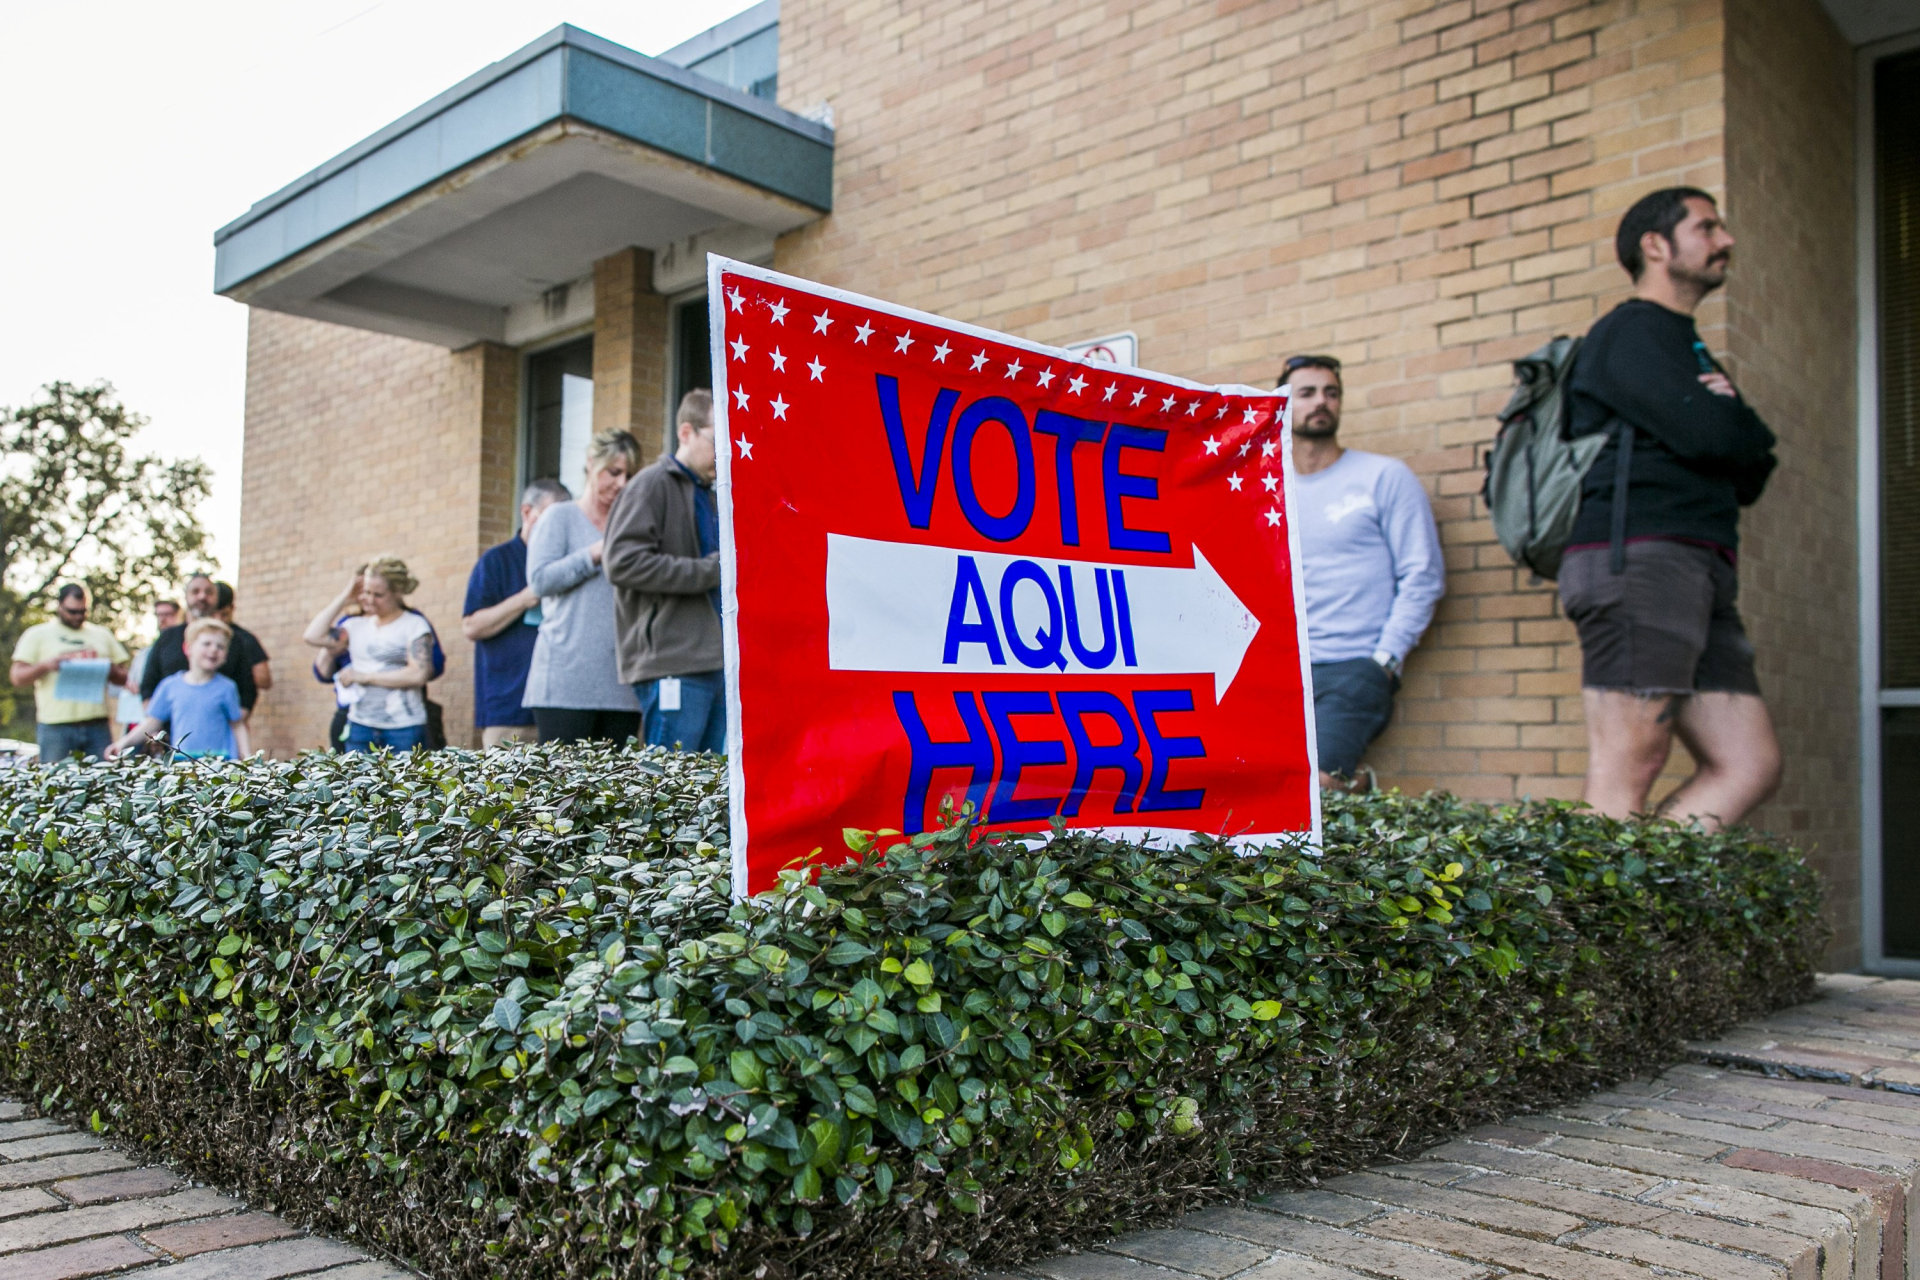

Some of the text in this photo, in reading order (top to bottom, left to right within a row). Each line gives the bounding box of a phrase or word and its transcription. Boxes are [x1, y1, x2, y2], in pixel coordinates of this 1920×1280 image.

[876, 374, 1171, 552] VOTE
[943, 556, 1137, 671] AQUI
[893, 690, 1206, 835] HERE
